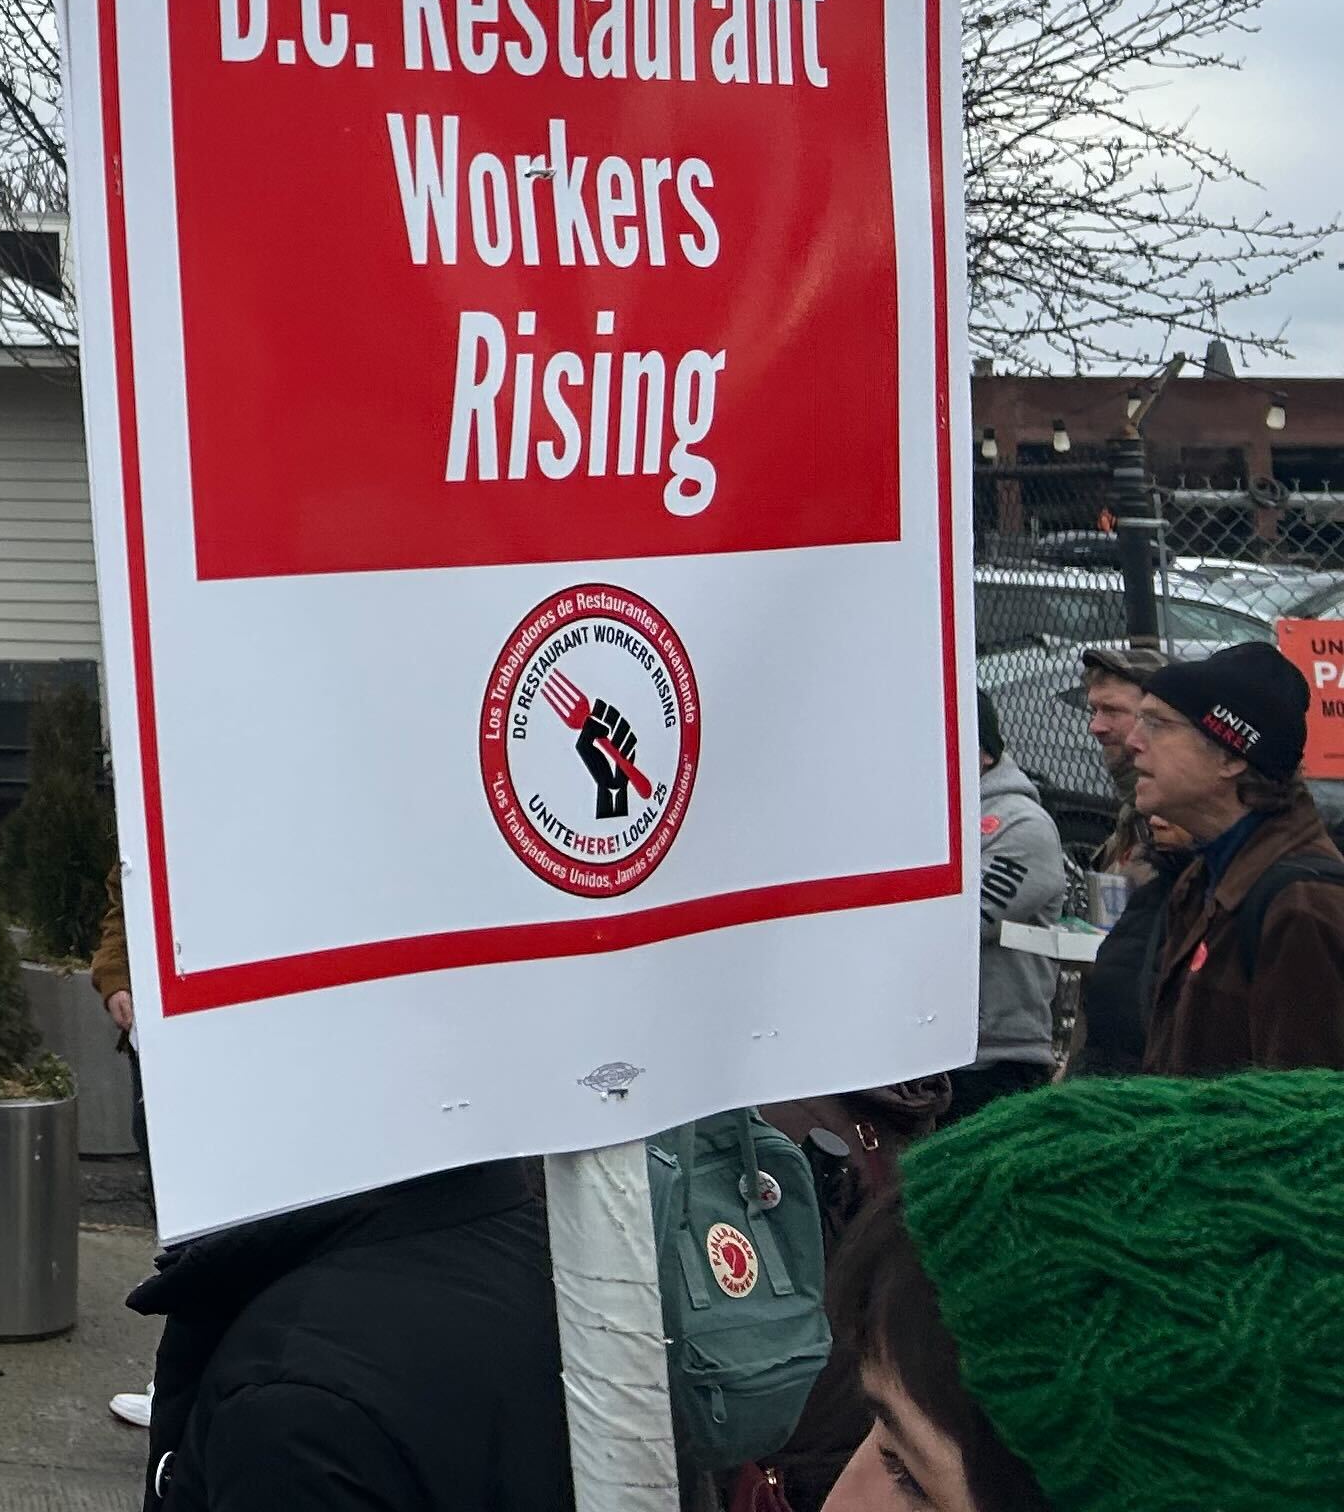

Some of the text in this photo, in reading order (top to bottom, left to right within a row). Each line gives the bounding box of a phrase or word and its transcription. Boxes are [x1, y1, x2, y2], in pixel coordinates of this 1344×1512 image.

[386, 112, 721, 270] Workers
[444, 310, 727, 518] Rising
[485, 592, 697, 740] Los Trabajadores de Restaurantes Levantando
[512, 624, 677, 740] DC RESTAURANT WORKERS RISING
[1213, 703, 1261, 745] UNITE
[504, 806, 567, 879] Trabajadores
[622, 805, 659, 848] LOCAL
[652, 781, 668, 807] 25
